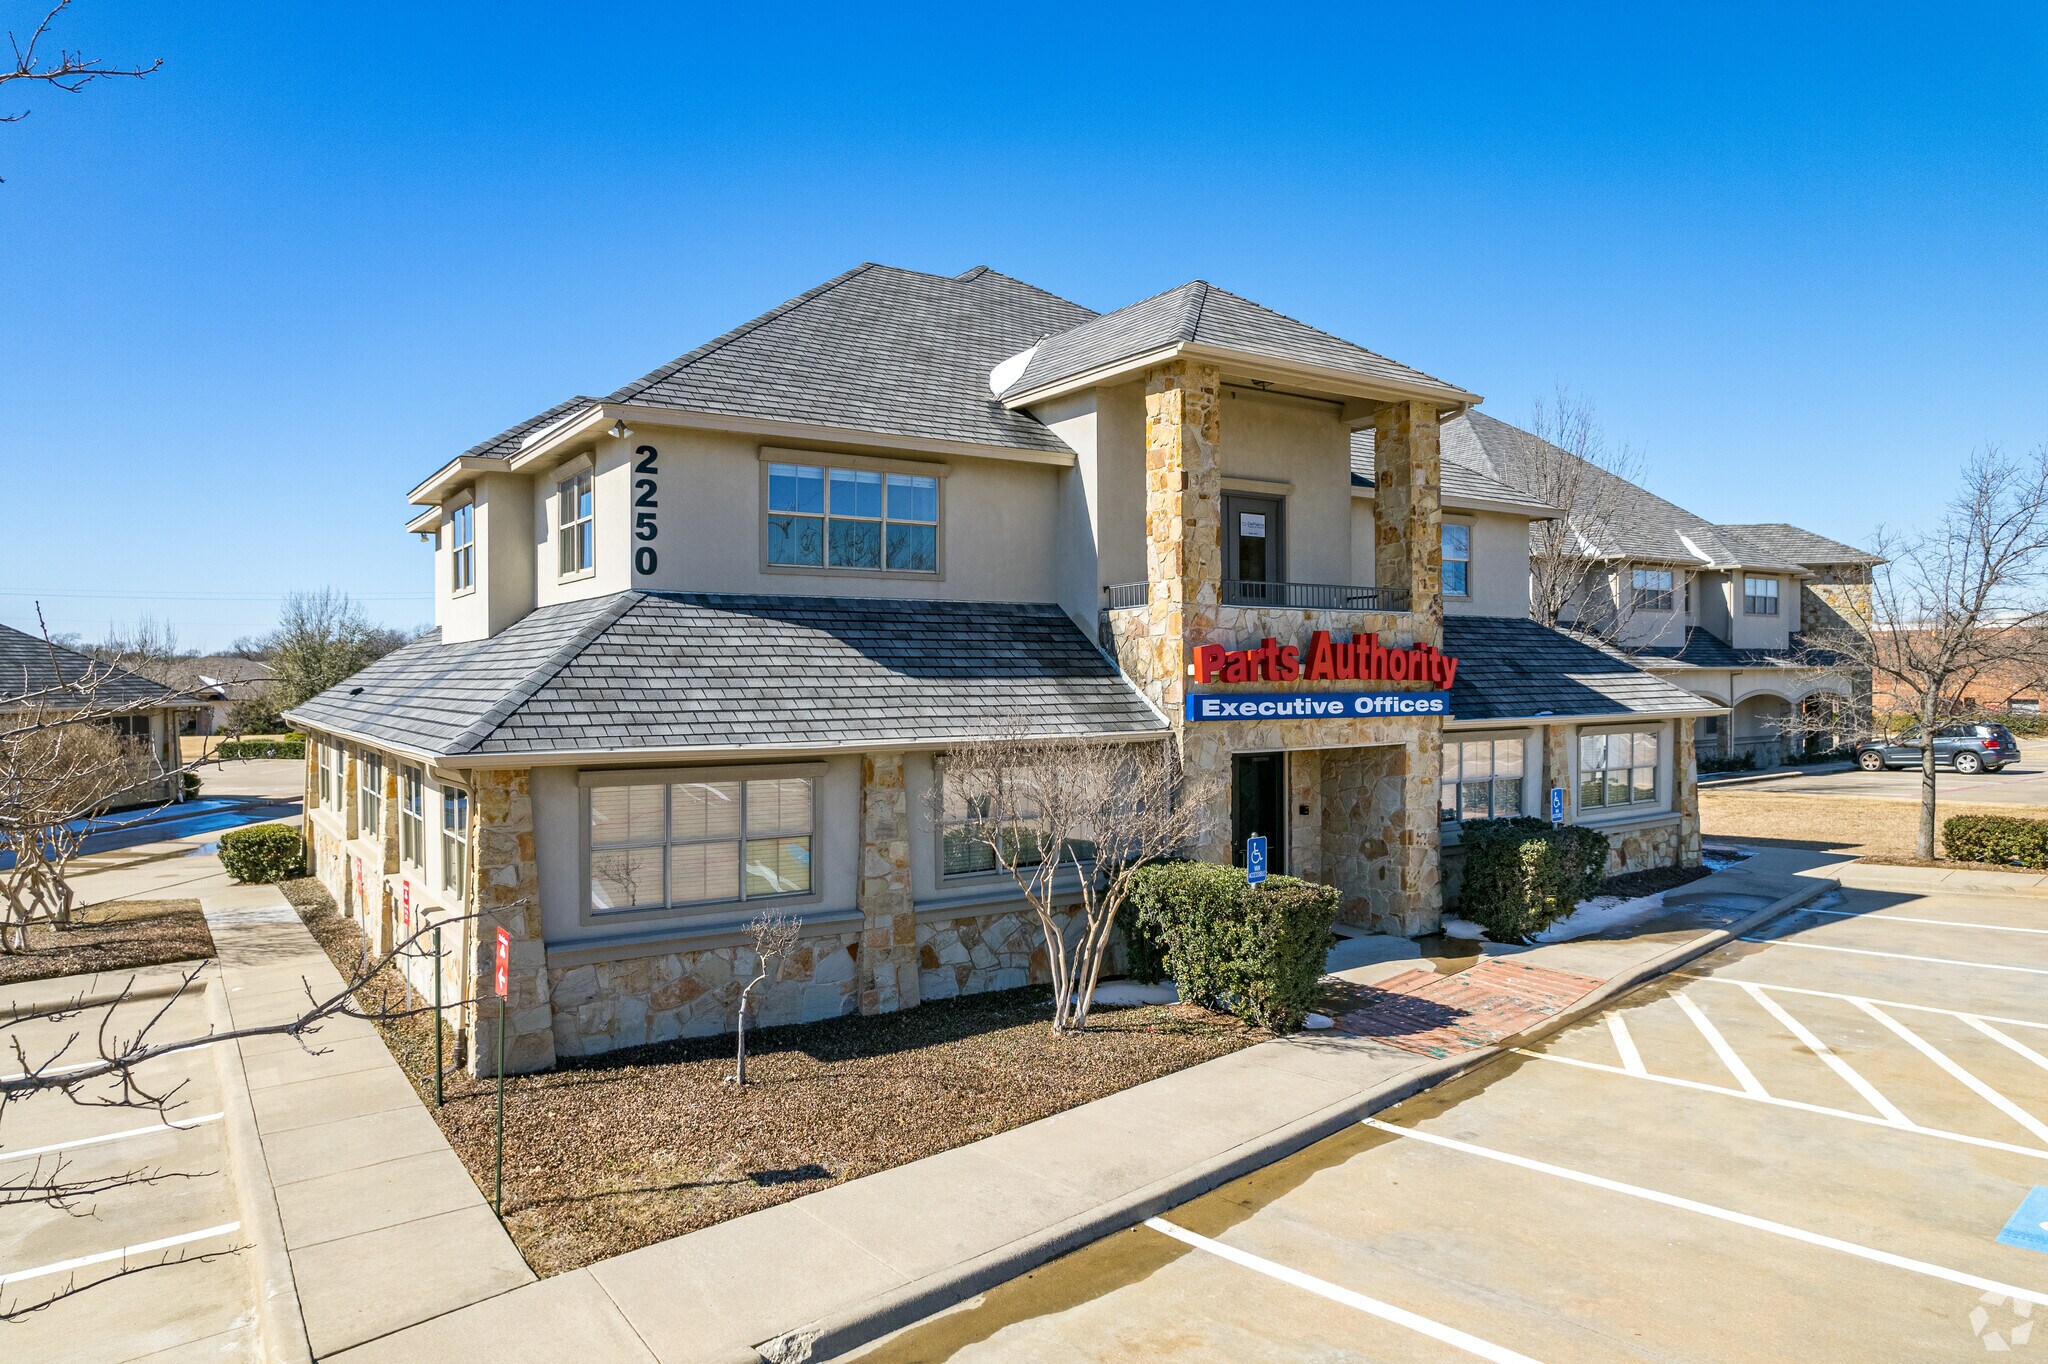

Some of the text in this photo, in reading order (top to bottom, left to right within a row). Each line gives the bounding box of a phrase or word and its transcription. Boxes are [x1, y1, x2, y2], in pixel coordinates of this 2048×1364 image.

[635, 445, 658, 575] 2250
[1193, 630, 1458, 690] Parts Authority
[1202, 697, 1443, 716] Executive Offices
